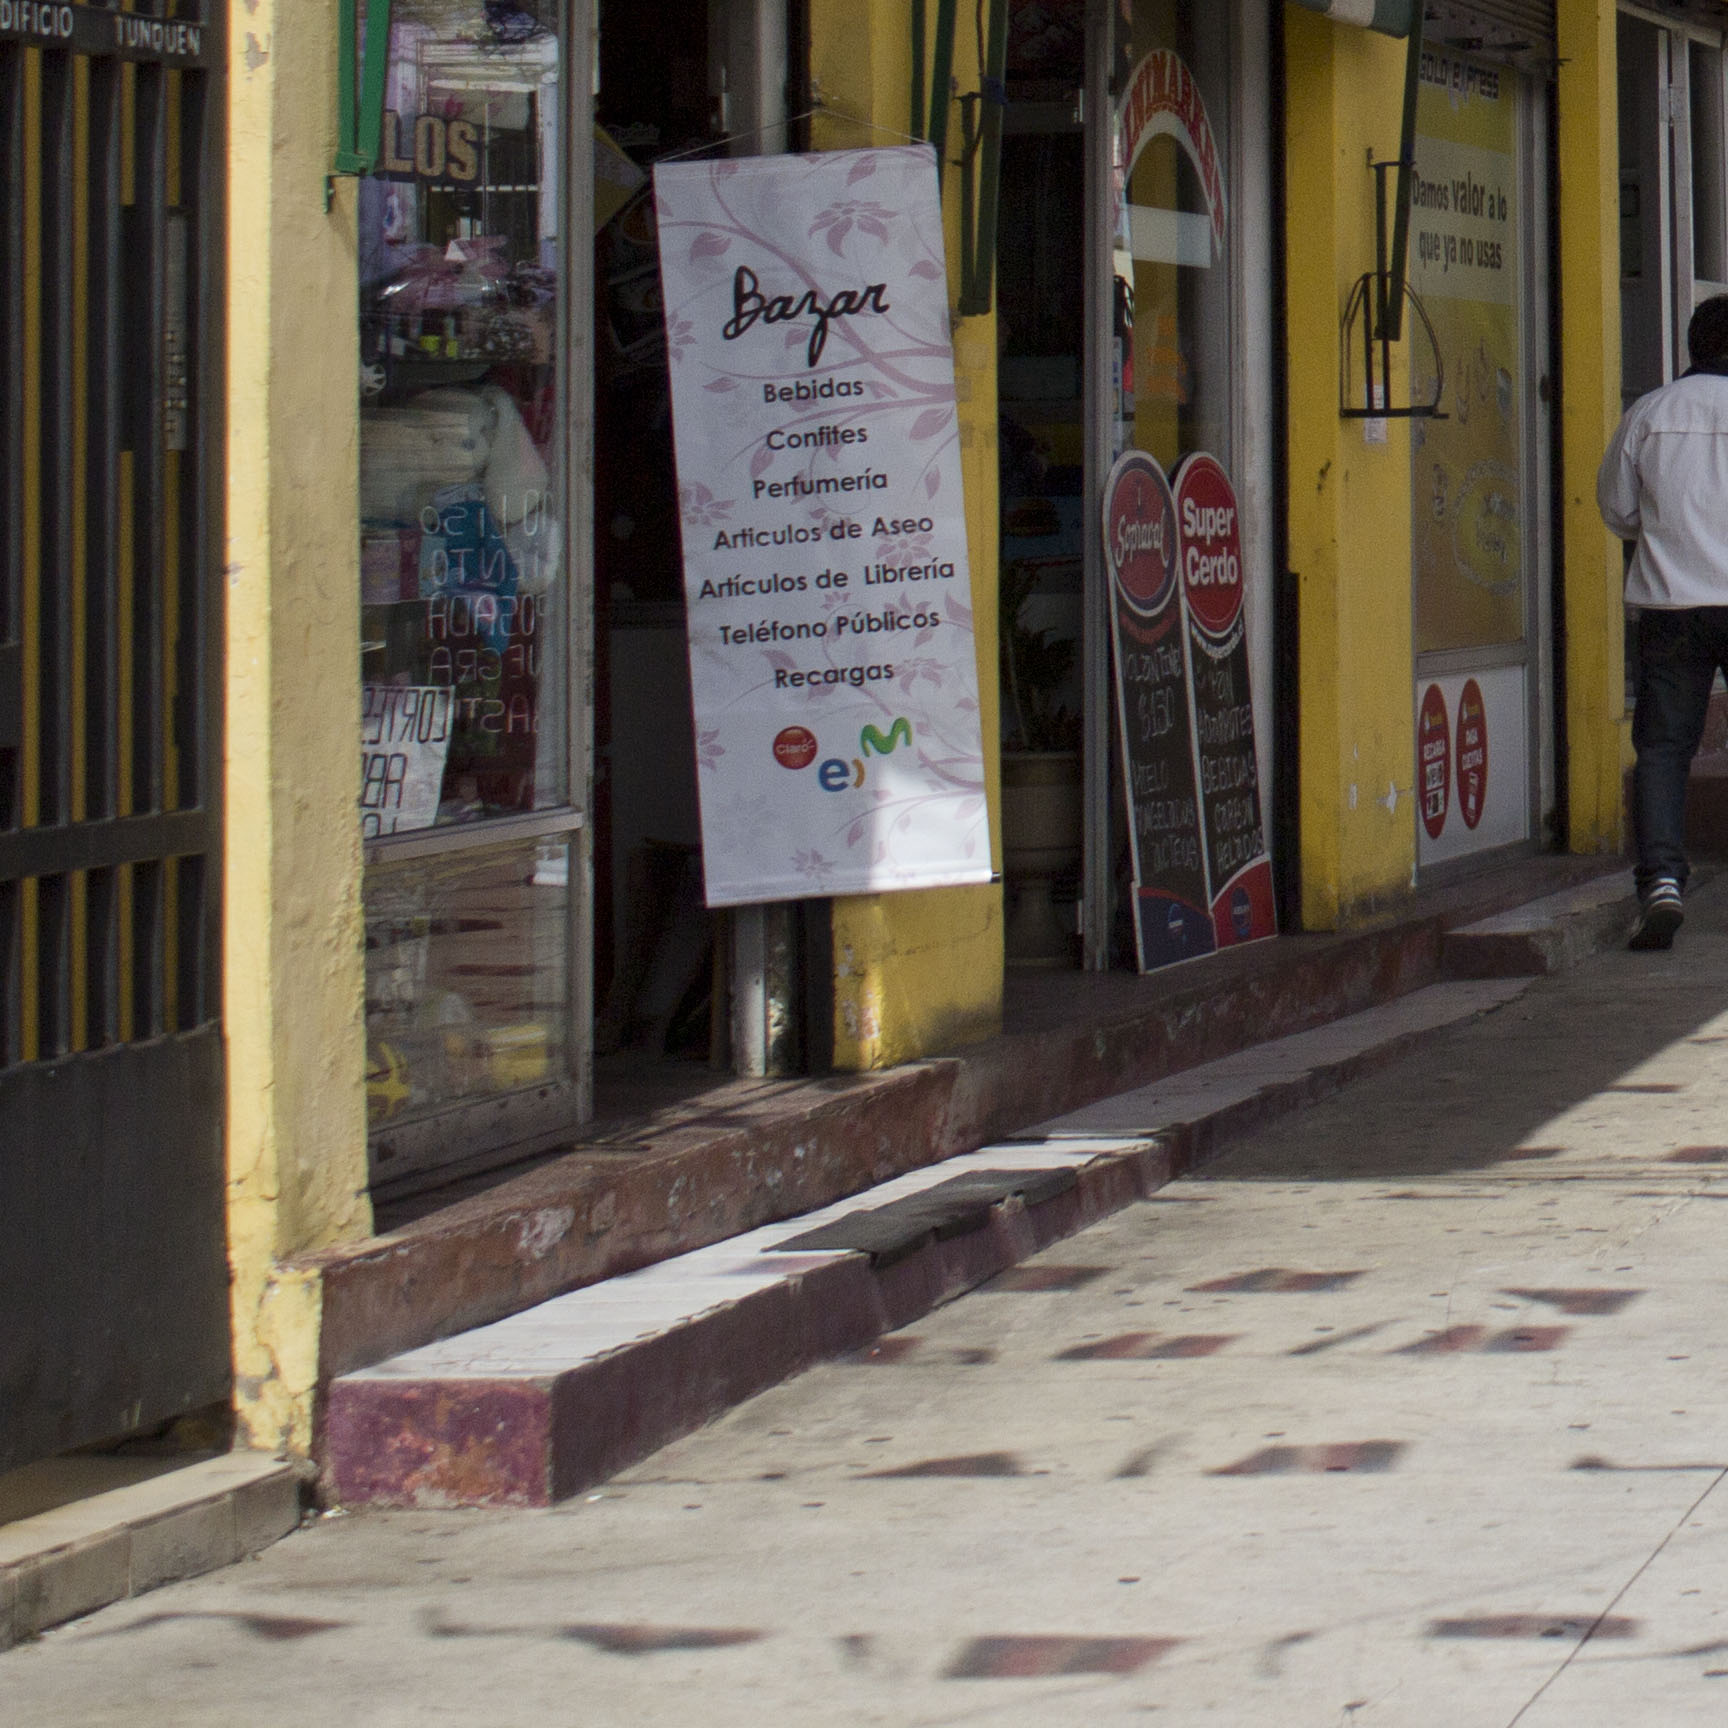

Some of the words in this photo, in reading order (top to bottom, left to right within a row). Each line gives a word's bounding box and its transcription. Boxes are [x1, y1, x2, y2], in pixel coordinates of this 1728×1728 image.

[1411, 169, 1449, 211] Damos
[1451, 169, 1486, 218] valor
[1419, 229, 1441, 270] que
[1442, 233, 1457, 274] ya
[1459, 237, 1474, 267] no
[1475, 240, 1503, 271] usas
[722, 264, 891, 369] Bazar
[763, 377, 865, 404] Bebidas
[765, 425, 869, 452] Confites
[752, 467, 889, 501] Perfumería
[713, 525, 822, 552] Articulos
[829, 519, 863, 543] de
[870, 516, 935, 539] Aseo
[1181, 496, 1235, 547] Super
[698, 573, 809, 601] Artículos
[815, 570, 850, 591] de
[863, 556, 955, 586] Librería
[1185, 545, 1239, 587] Cerdo
[719, 618, 828, 646] Teléfono
[835, 609, 941, 636] Públicos
[774, 662, 895, 690] Recargas
